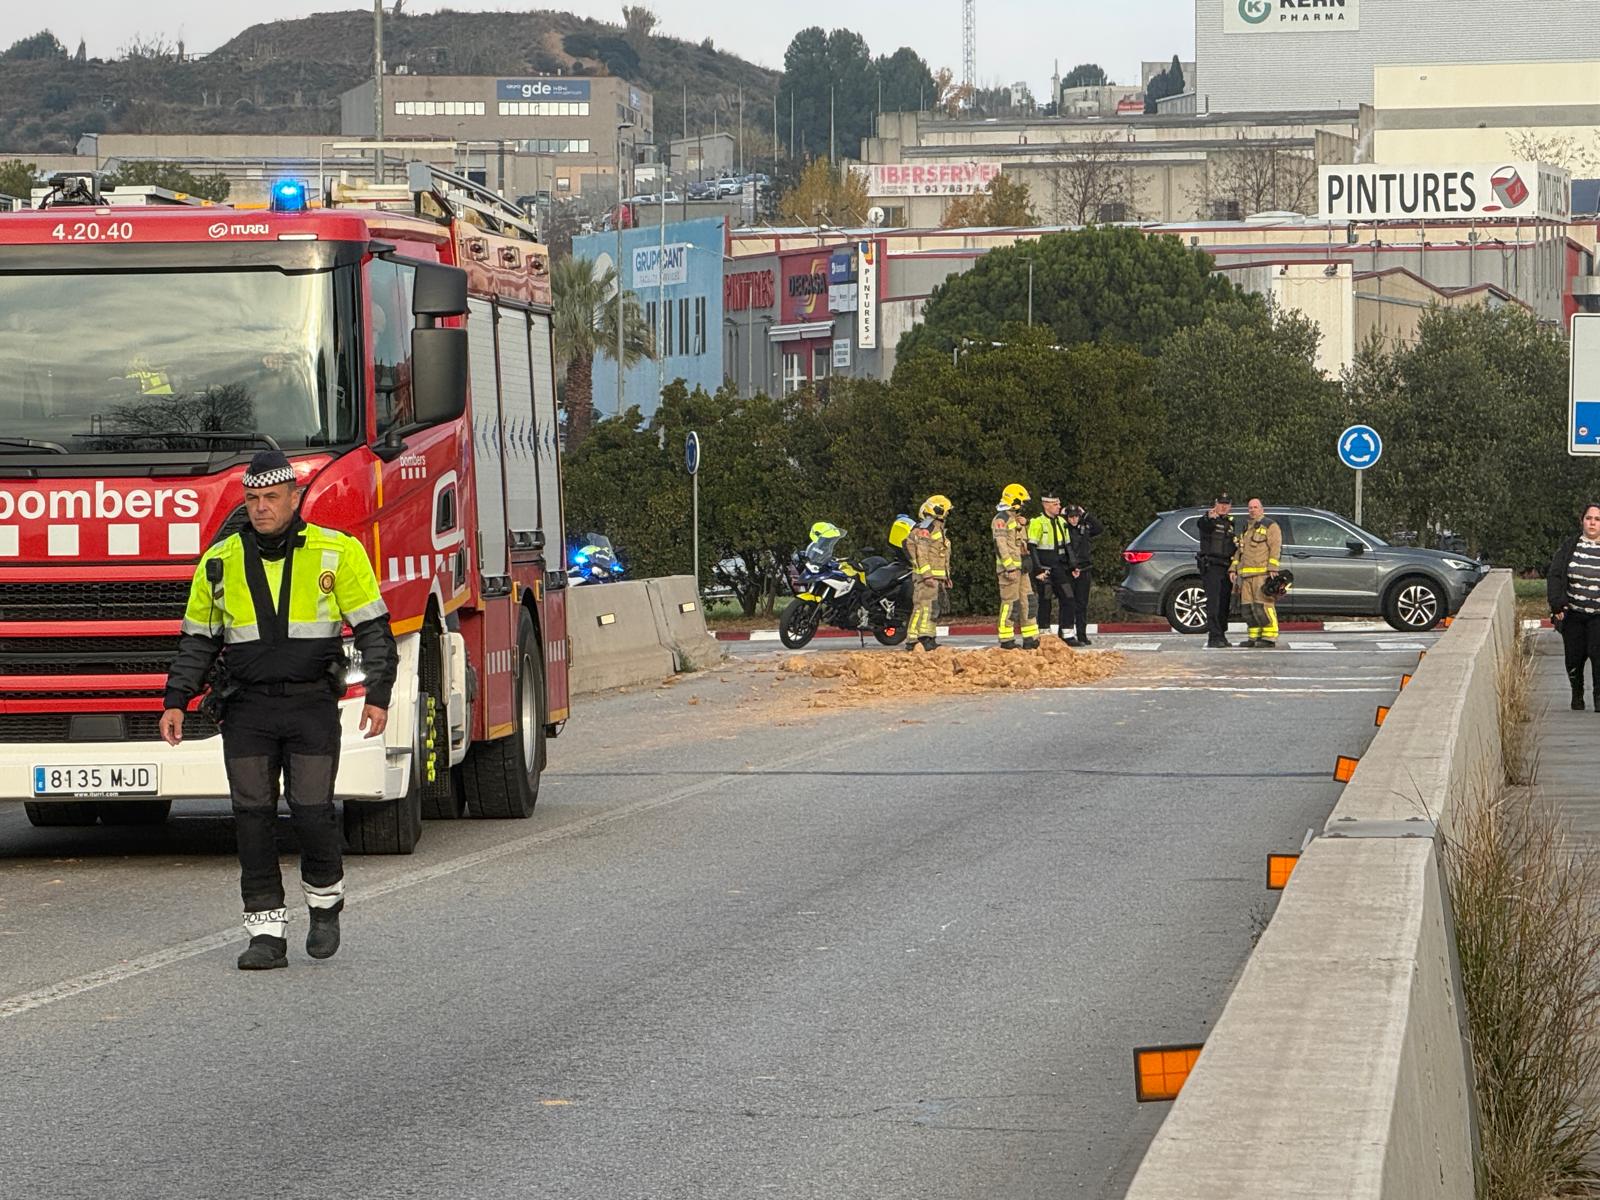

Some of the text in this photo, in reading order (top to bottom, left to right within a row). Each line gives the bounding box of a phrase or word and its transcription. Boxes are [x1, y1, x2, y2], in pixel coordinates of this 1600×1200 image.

[1280, 13, 1345, 21] PHARMA
[522, 82, 551, 97] gde
[925, 185, 938, 193] 93
[1328, 172, 1476, 214] PINTURES
[52, 222, 133, 240] 4.20.40
[230, 224, 269, 235] ITURRI
[51, 768, 149, 788] 8135 MJD
